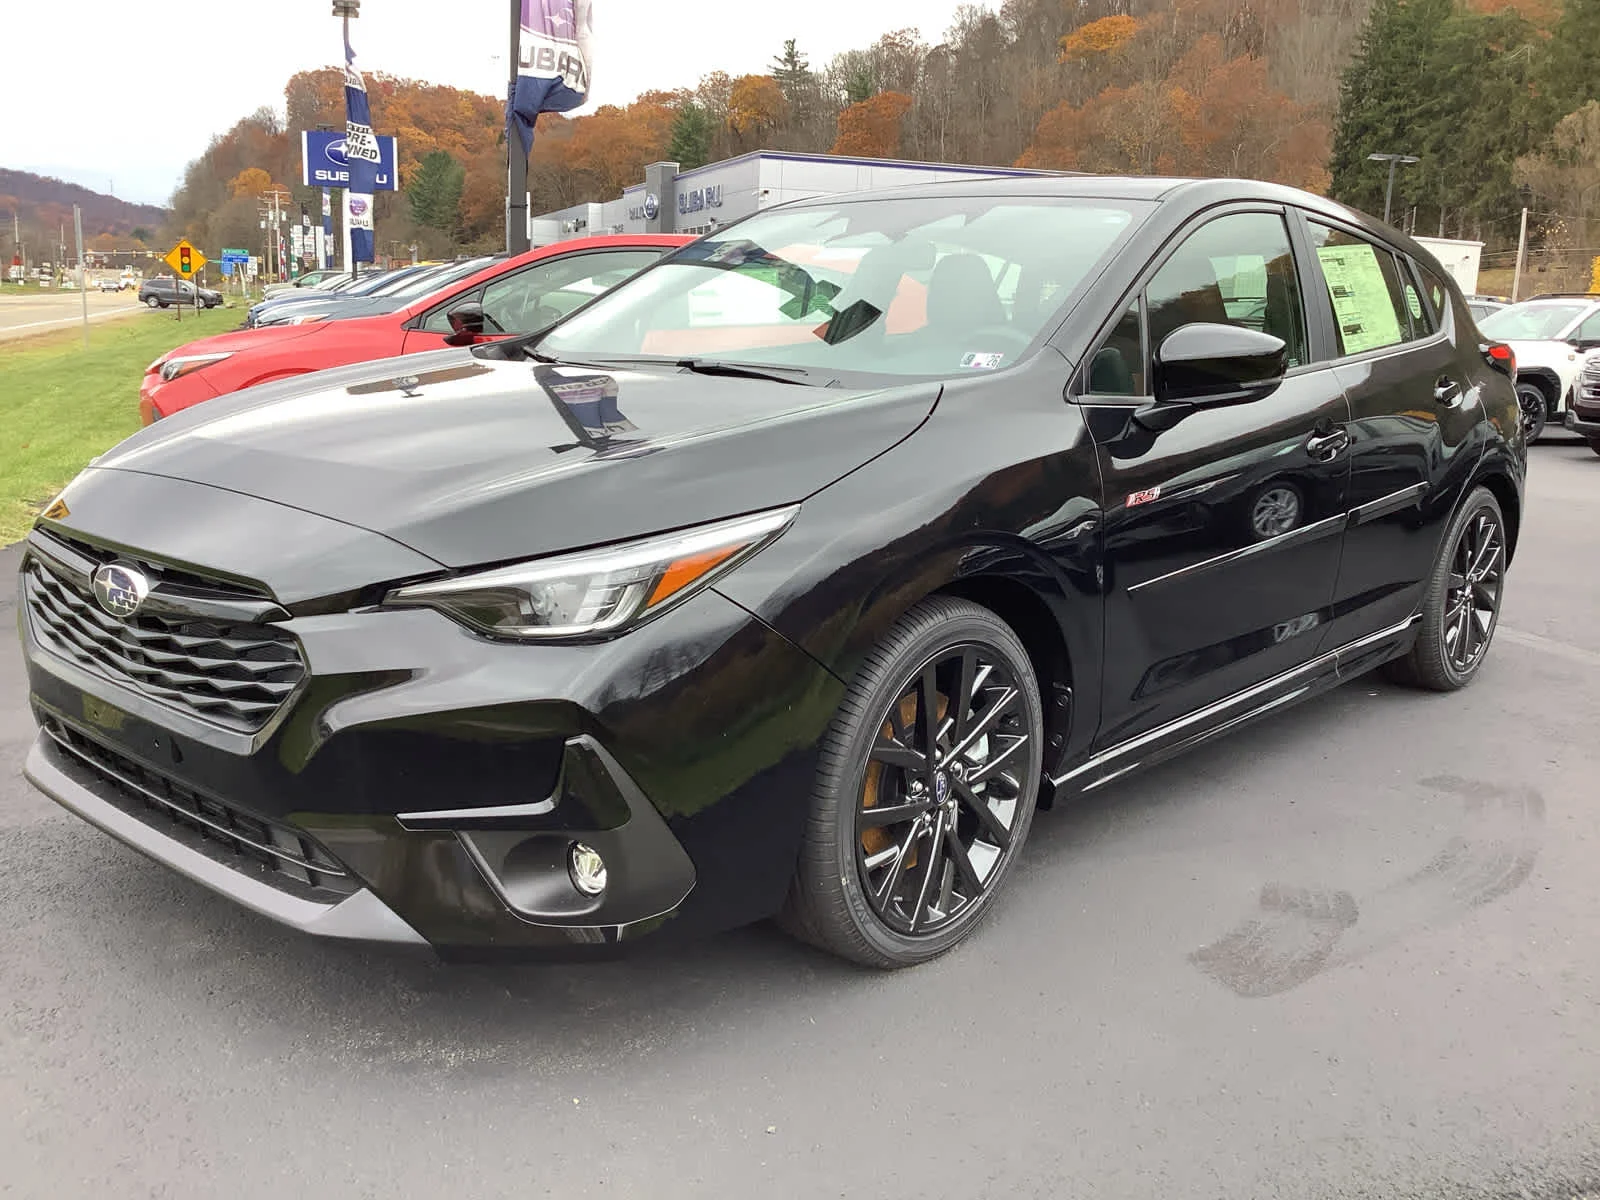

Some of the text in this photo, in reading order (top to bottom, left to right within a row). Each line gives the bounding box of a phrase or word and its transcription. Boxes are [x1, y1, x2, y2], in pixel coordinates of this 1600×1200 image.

[519, 46, 587, 86] UBAR
[315, 169, 388, 185] SUBU
[678, 184, 724, 215] SUBARU
[1128, 487, 1158, 506] RS
